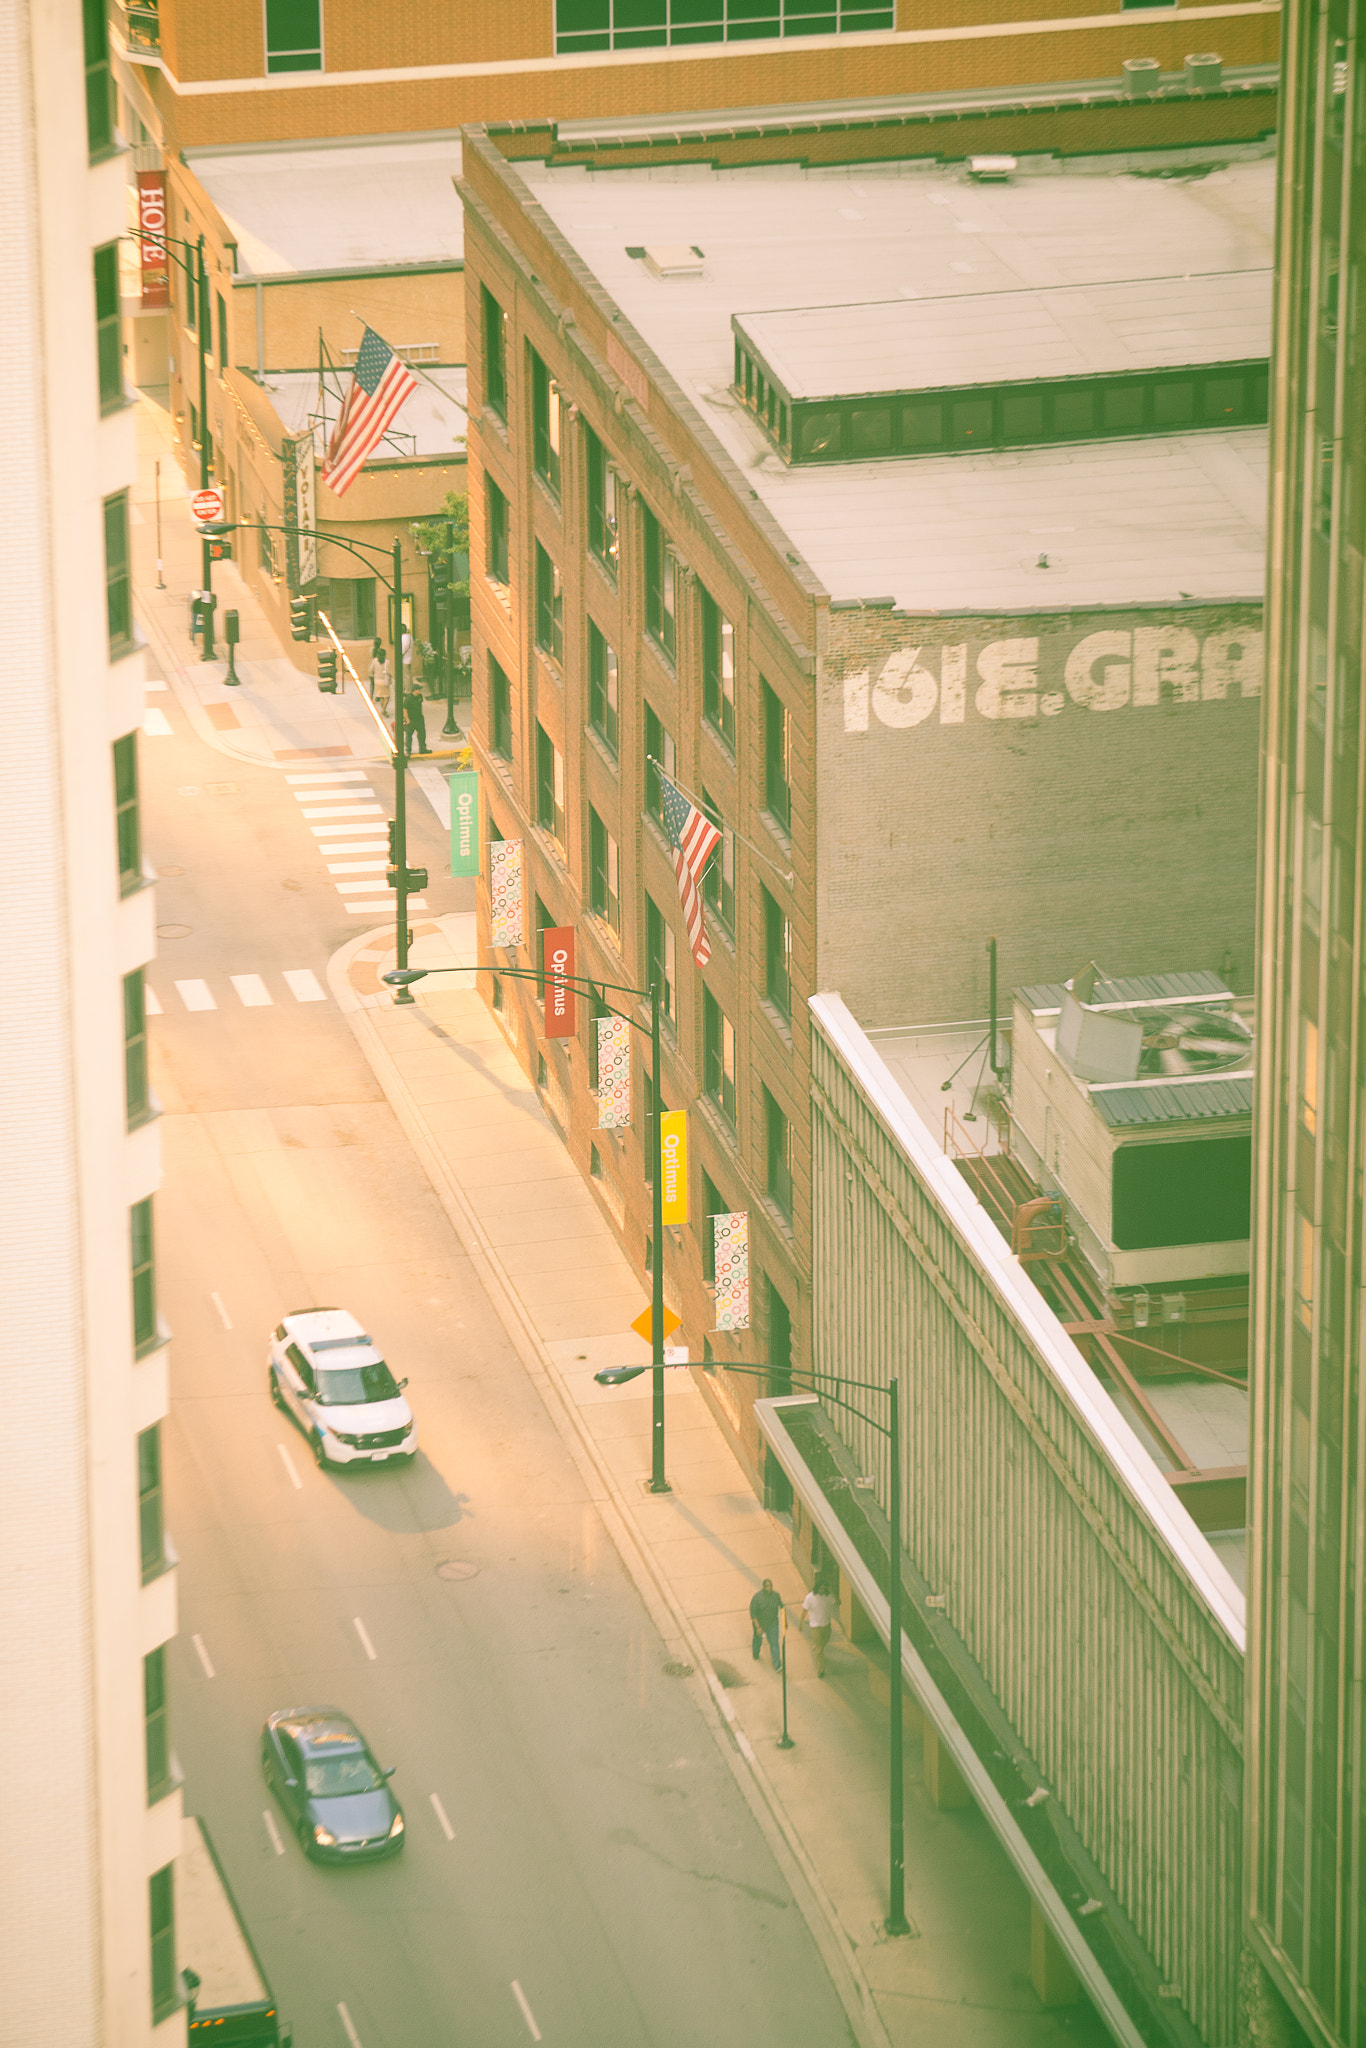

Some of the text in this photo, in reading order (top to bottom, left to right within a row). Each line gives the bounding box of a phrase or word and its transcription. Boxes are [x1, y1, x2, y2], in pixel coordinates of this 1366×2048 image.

[141, 187, 167, 263] HOPE
[456, 793, 473, 857] Optimus
[662, 1134, 680, 1203] Optimus
